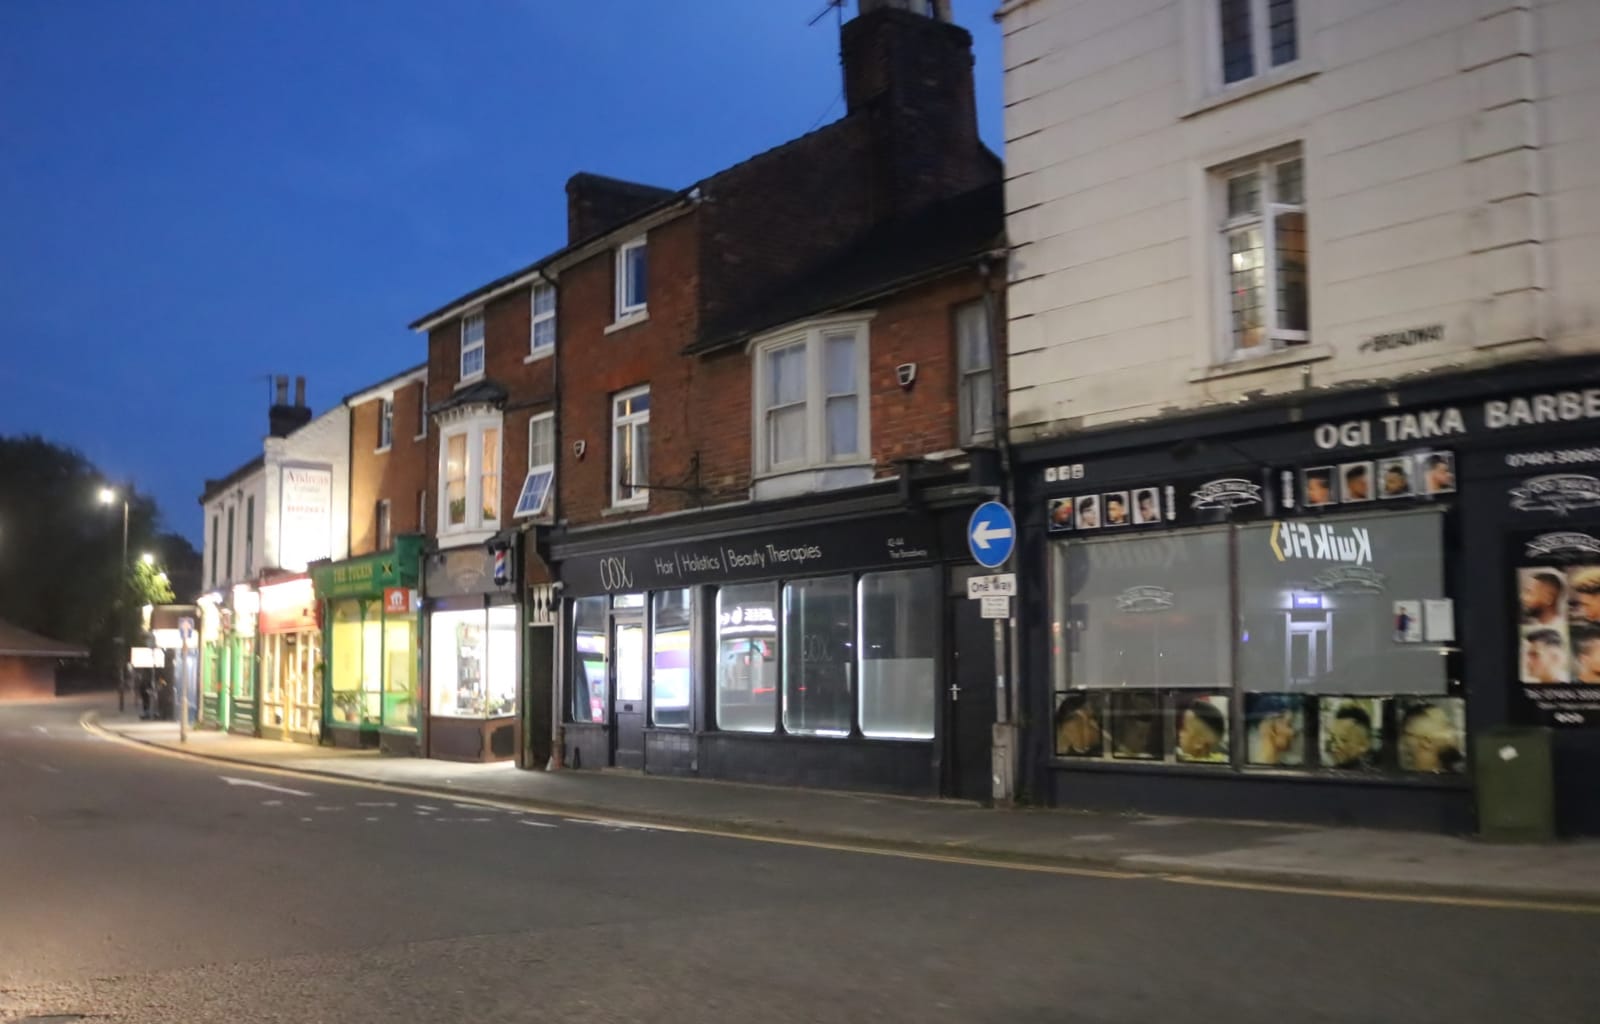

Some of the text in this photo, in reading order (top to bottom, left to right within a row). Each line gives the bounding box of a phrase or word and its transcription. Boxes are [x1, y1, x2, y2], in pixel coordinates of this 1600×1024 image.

[1373, 324, 1445, 352] BROADWAY
[1314, 420, 1371, 449] OGI
[1381, 407, 1467, 442] TAKA
[600, 555, 633, 591] COX
[655, 544, 822, 575] Hair Holistics Beauty Therapies
[971, 582, 989, 593] One
